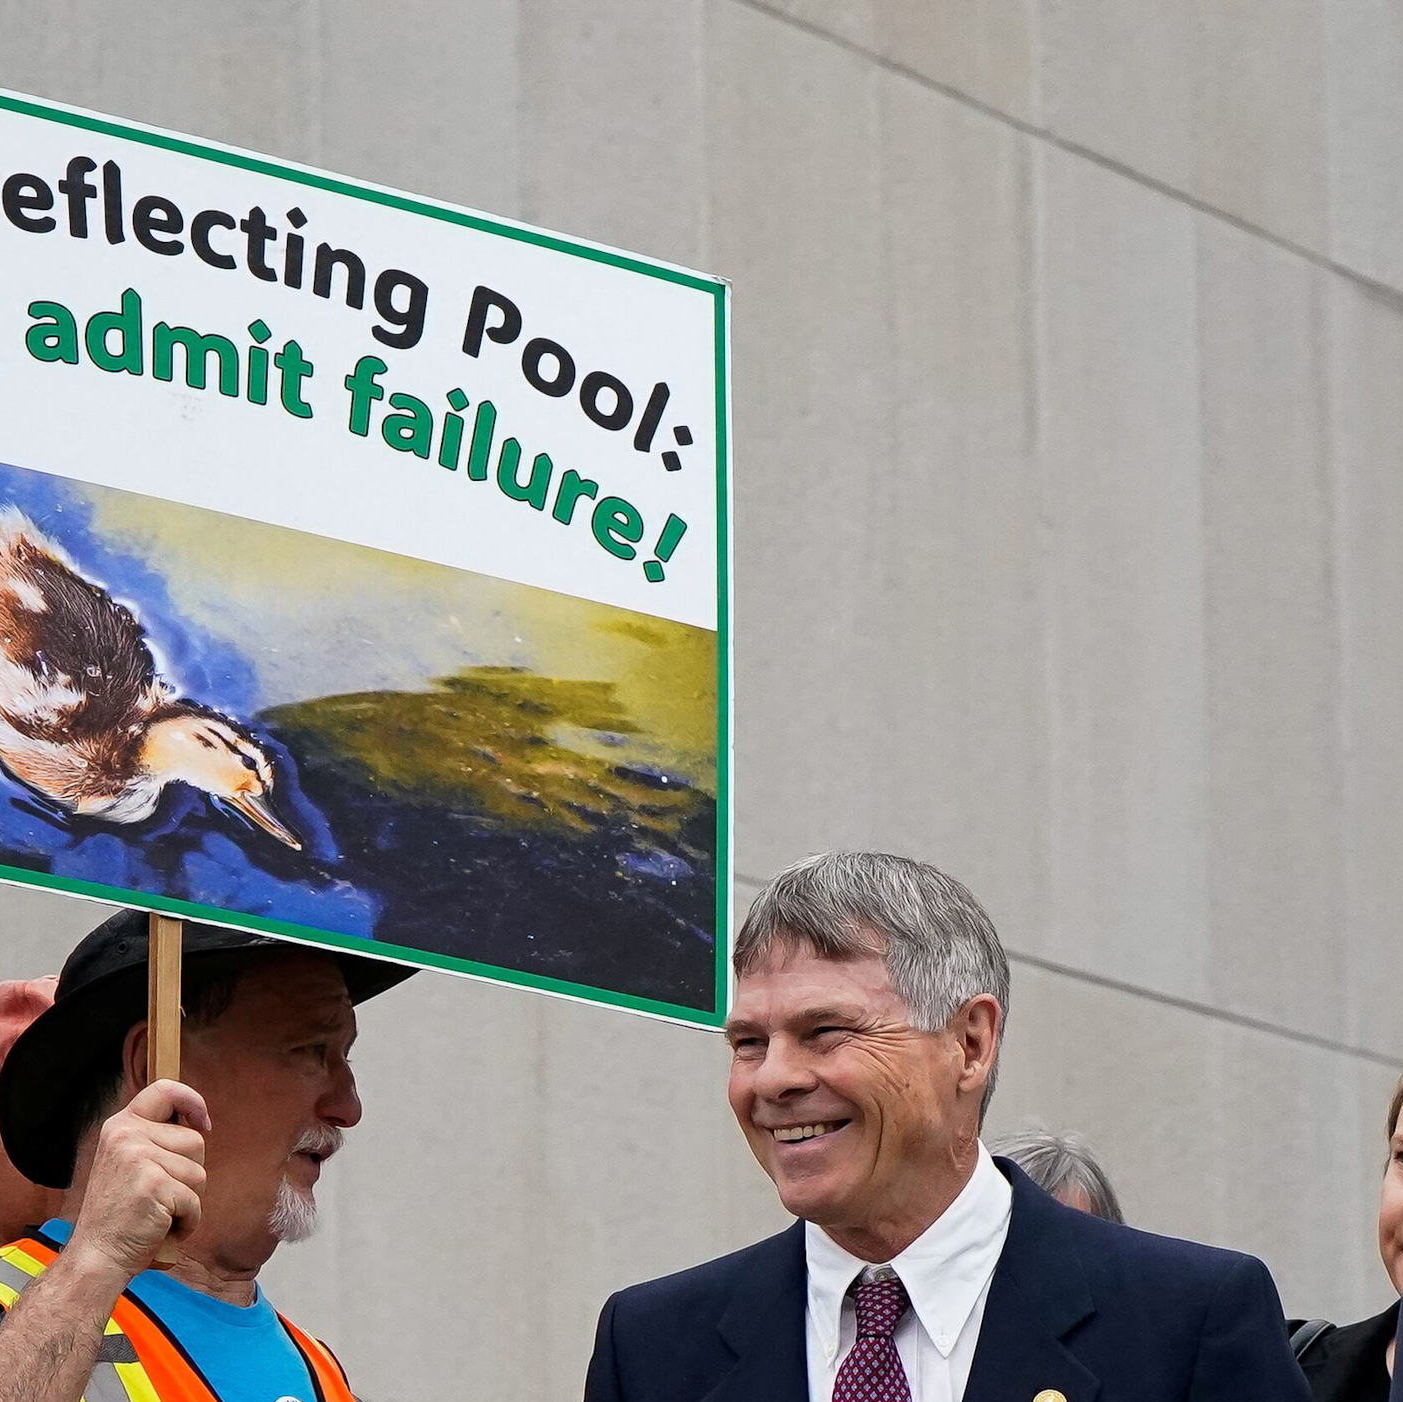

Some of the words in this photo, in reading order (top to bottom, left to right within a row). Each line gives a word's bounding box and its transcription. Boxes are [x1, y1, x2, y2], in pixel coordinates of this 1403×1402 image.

[26, 288, 313, 418] admit
[344, 356, 687, 582] failure!
[463, 290, 693, 471] Pool:
